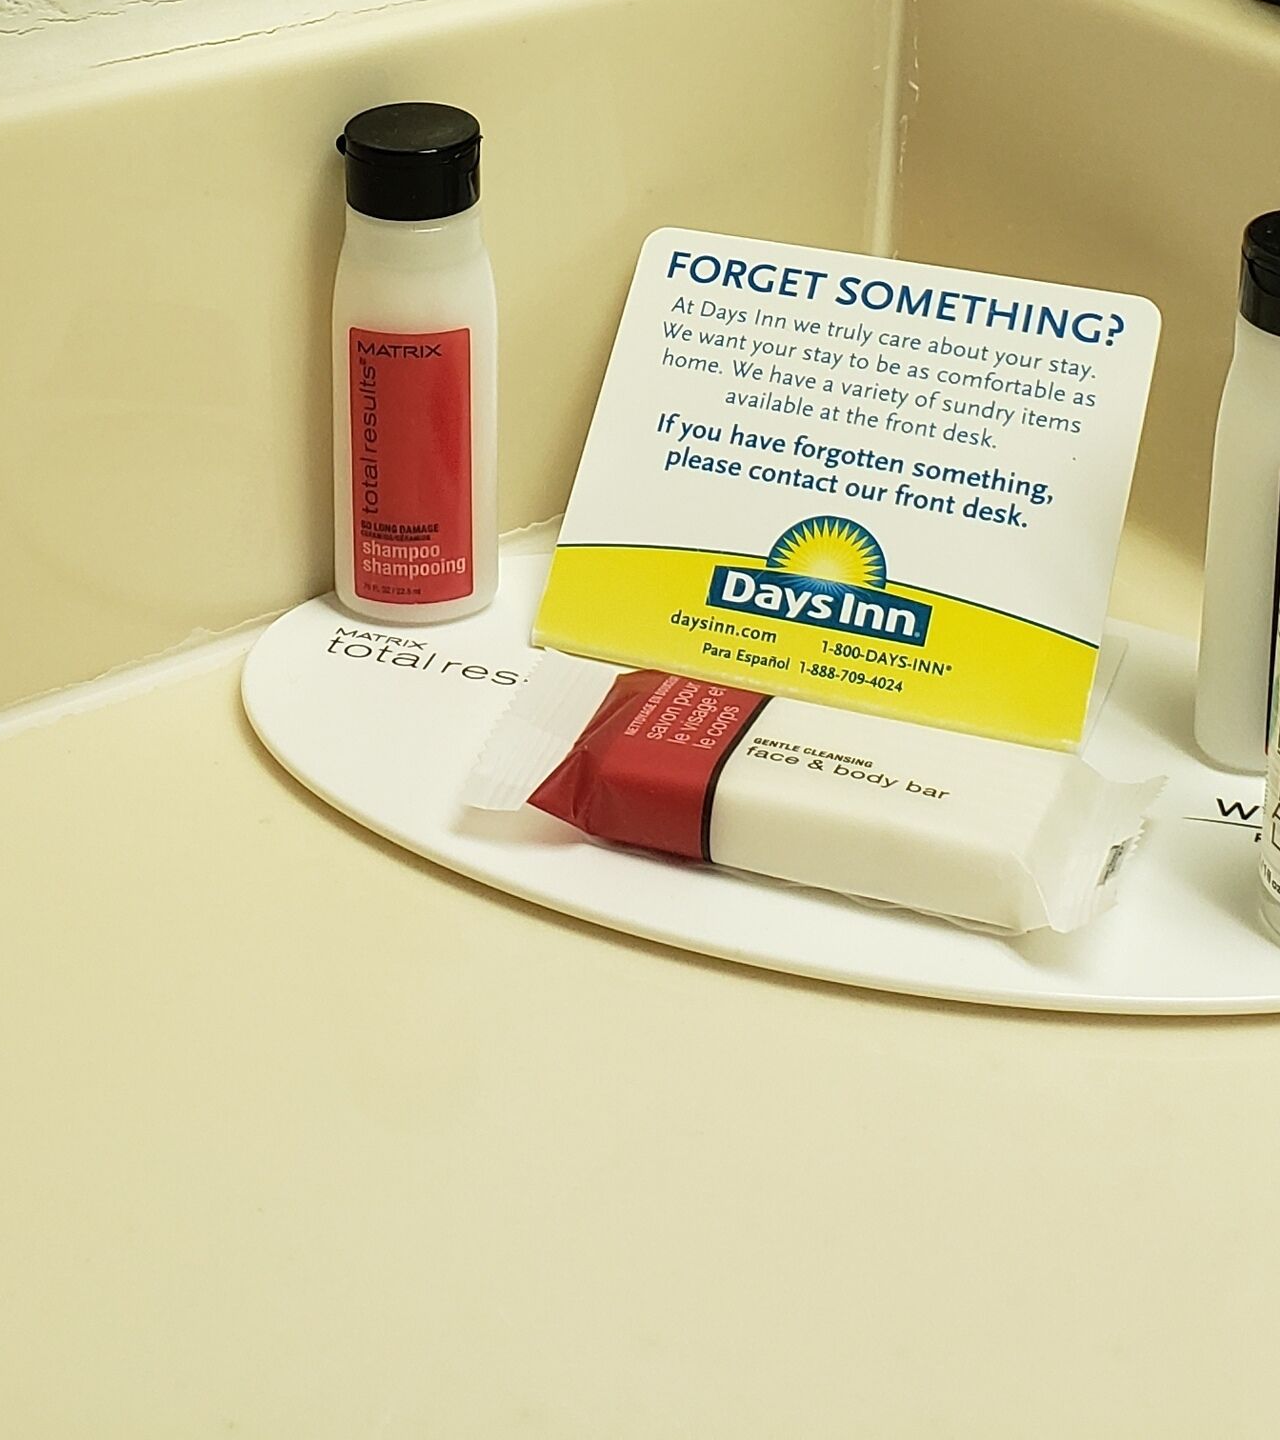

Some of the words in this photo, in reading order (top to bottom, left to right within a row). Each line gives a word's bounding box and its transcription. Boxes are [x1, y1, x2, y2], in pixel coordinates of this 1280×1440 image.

[667, 251, 828, 300] FORGET
[835, 277, 1124, 346] SOMETHING?
[357, 340, 442, 358] MATRIX
[671, 296, 695, 315] At
[700, 301, 747, 325] Days
[755, 309, 786, 329] Inn
[794, 318, 820, 334] we
[828, 321, 872, 347] truly
[878, 332, 921, 350] care
[928, 336, 989, 361] about
[993, 351, 1043, 369] your
[1049, 359, 1096, 382] stay.
[663, 321, 693, 341] We
[699, 331, 747, 350] want
[750, 340, 797, 358] your
[802, 346, 844, 370] stay
[849, 353, 869, 370] to
[876, 354, 901, 375] be
[907, 363, 930, 380] as
[937, 368, 1065, 402] comfortable
[1072, 390, 1096, 407] as
[662, 347, 723, 375] home.
[733, 360, 764, 381] We
[769, 365, 816, 389] have
[822, 379, 833, 392] a
[841, 381, 909, 408] variety
[914, 391, 941, 409] of
[942, 398, 1015, 427] sundry
[1021, 407, 1082, 433] items
[725, 391, 813, 417] available
[820, 406, 840, 422] at
[846, 406, 879, 428] the
[886, 412, 936, 438] front
[942, 423, 997, 449] desk.
[657, 413, 681, 434] If
[677, 420, 722, 442] you
[729, 423, 786, 453] have
[793, 435, 904, 474] forgotten
[912, 461, 1054, 505] something,
[664, 446, 742, 477] please
[749, 464, 838, 494] contact
[845, 481, 888, 502] our
[895, 484, 955, 515] front
[962, 497, 1028, 528] desk.
[362, 540, 440, 562] shampoo
[373, 522, 397, 533] LONG
[399, 523, 439, 534] DAMAGE
[362, 557, 466, 580] shampooing
[670, 610, 777, 643] daysinn.com
[722, 570, 834, 619] Days
[838, 593, 917, 637] Inn
[327, 636, 437, 670] total
[441, 661, 529, 686] res
[336, 627, 428, 650] MATRIX
[702, 643, 732, 660] Para
[736, 649, 790, 671] Español
[799, 661, 903, 693] 1-888-709-4024
[647, 707, 682, 740] savon
[667, 732, 691, 745] le
[680, 697, 718, 732] visage
[692, 737, 716, 750] le
[707, 705, 740, 738] corps
[746, 746, 800, 765] face
[807, 759, 824, 771] &
[833, 764, 899, 789] body
[905, 780, 951, 800] bar
[753, 737, 801, 753] GENTLE
[803, 747, 874, 768] CLEANSING
